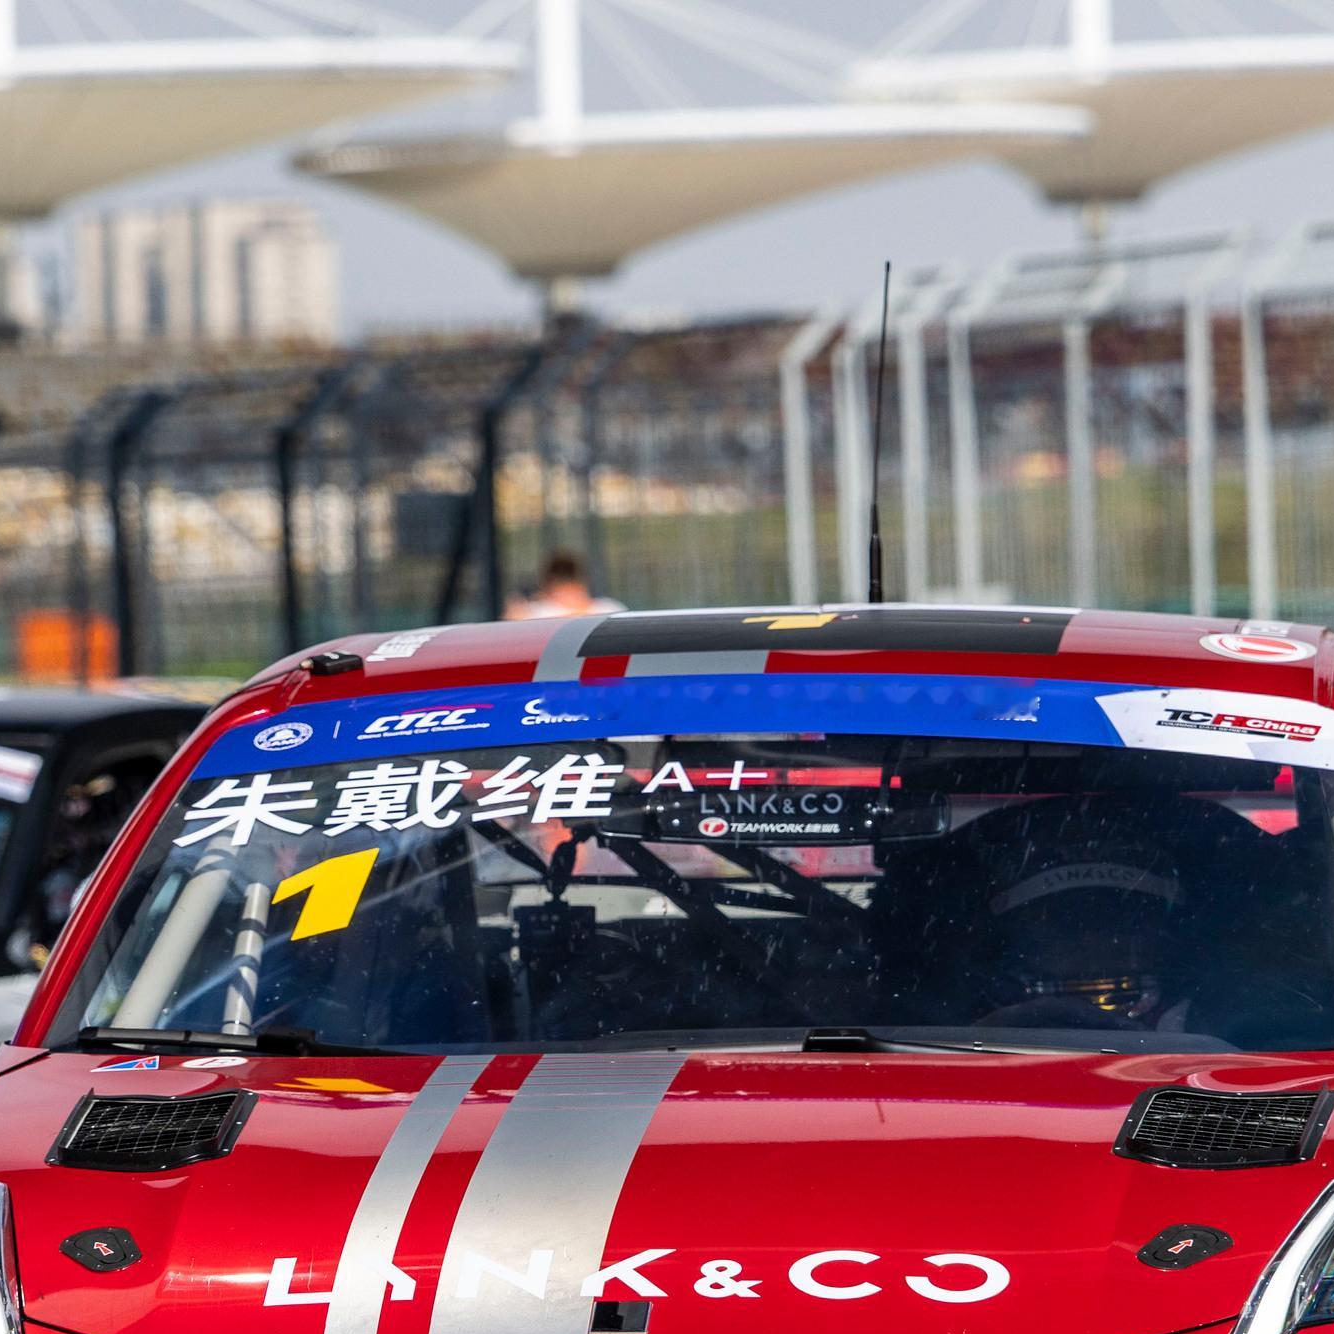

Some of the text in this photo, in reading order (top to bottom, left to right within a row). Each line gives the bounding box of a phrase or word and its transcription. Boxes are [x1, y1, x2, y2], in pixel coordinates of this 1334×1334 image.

[364, 708, 477, 734] CTCC
[1245, 718, 1316, 734] China
[641, 760, 768, 793] A+
[173, 753, 624, 848] 朱戴维
[271, 847, 380, 941] 1
